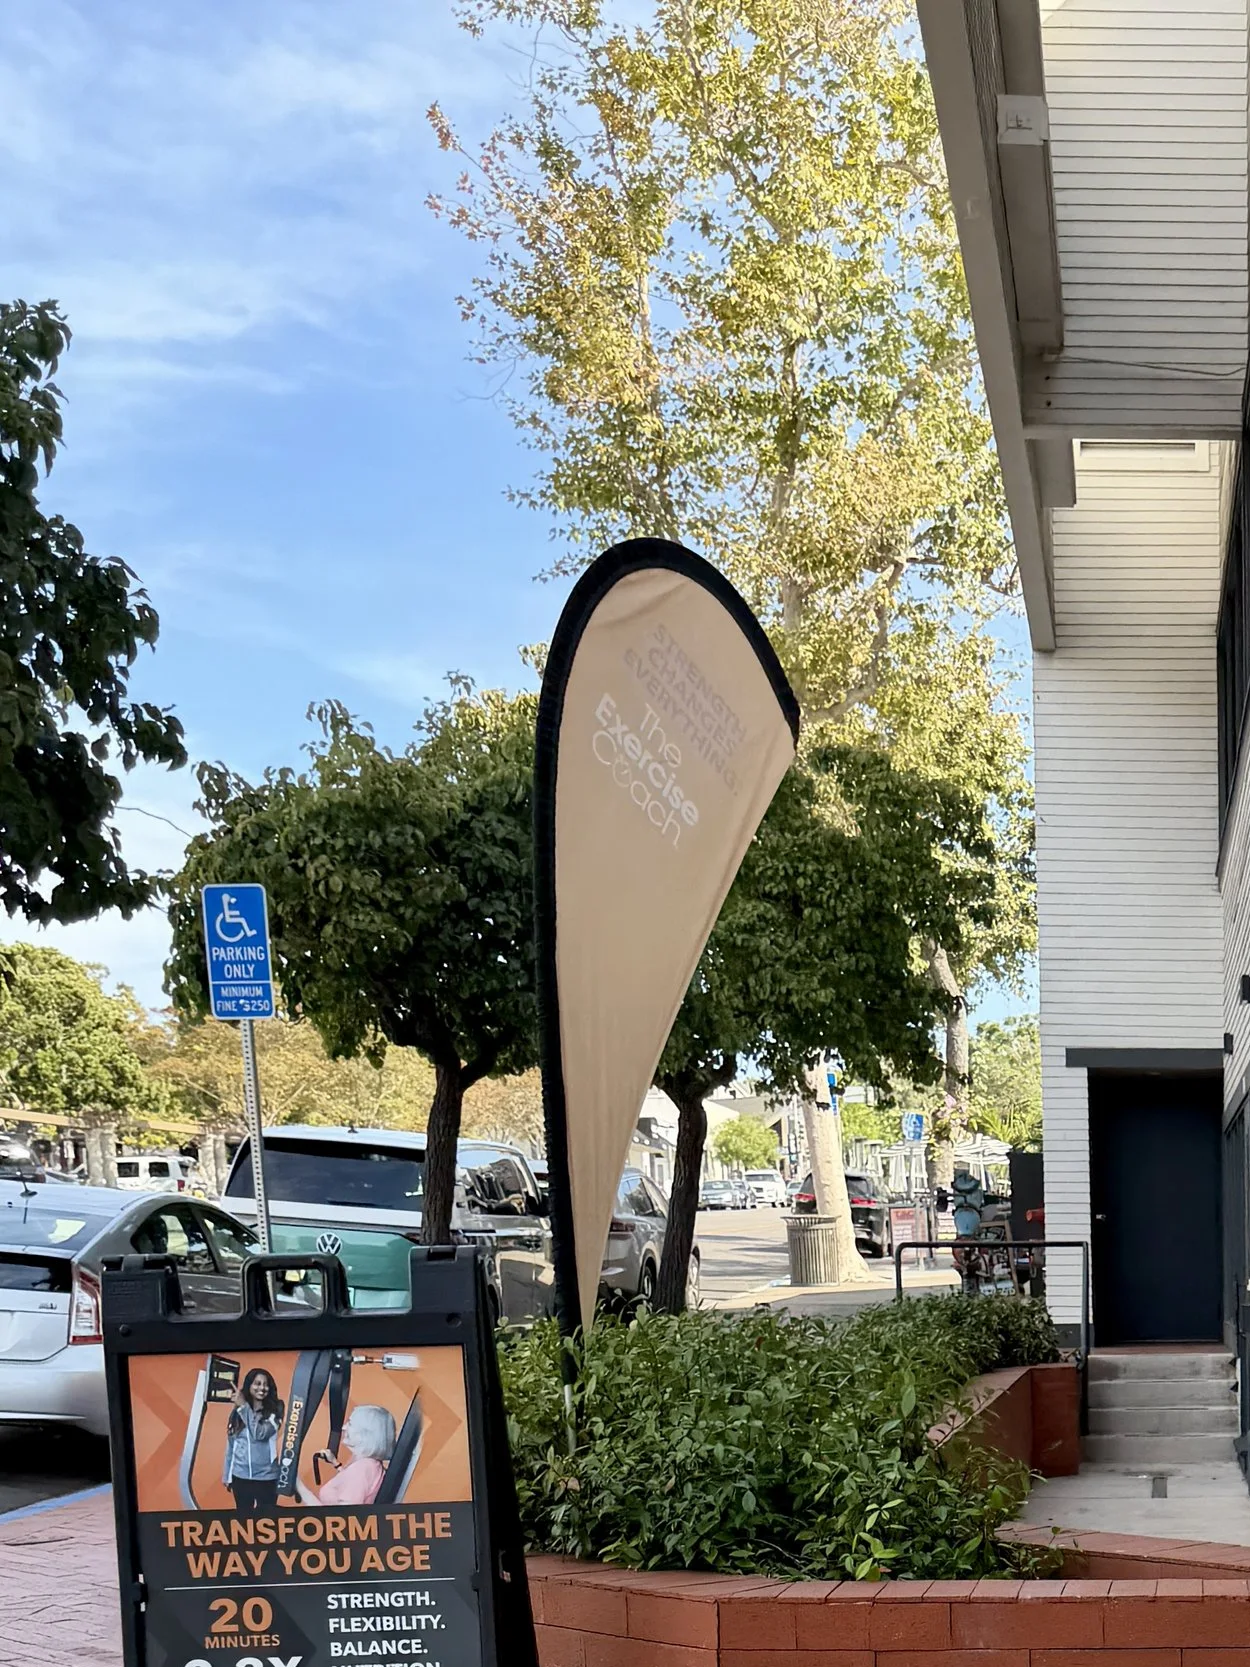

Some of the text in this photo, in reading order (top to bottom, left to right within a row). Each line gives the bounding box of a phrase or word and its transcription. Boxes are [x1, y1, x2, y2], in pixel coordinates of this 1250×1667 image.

[653, 624, 747, 742] STRENGTH
[648, 649, 737, 757] CHANGES
[639, 702, 682, 768] The
[595, 692, 699, 826] Exercise
[592, 730, 681, 848] Coach
[212, 946, 265, 961] PARKING
[224, 964, 256, 979] ONLY
[220, 986, 263, 997] MINIMUM
[216, 1000, 271, 1012] FINE $250
[160, 1512, 452, 1548] TRANSFORM THE
[187, 1545, 431, 1579] WAY YOU AGE
[327, 1591, 436, 1609] STRENGTH.
[208, 1596, 273, 1633] 20
[328, 1614, 446, 1633] FLEXIBILITY.
[204, 1634, 280, 1649] MINUTES
[330, 1639, 428, 1657] BALANCE.
